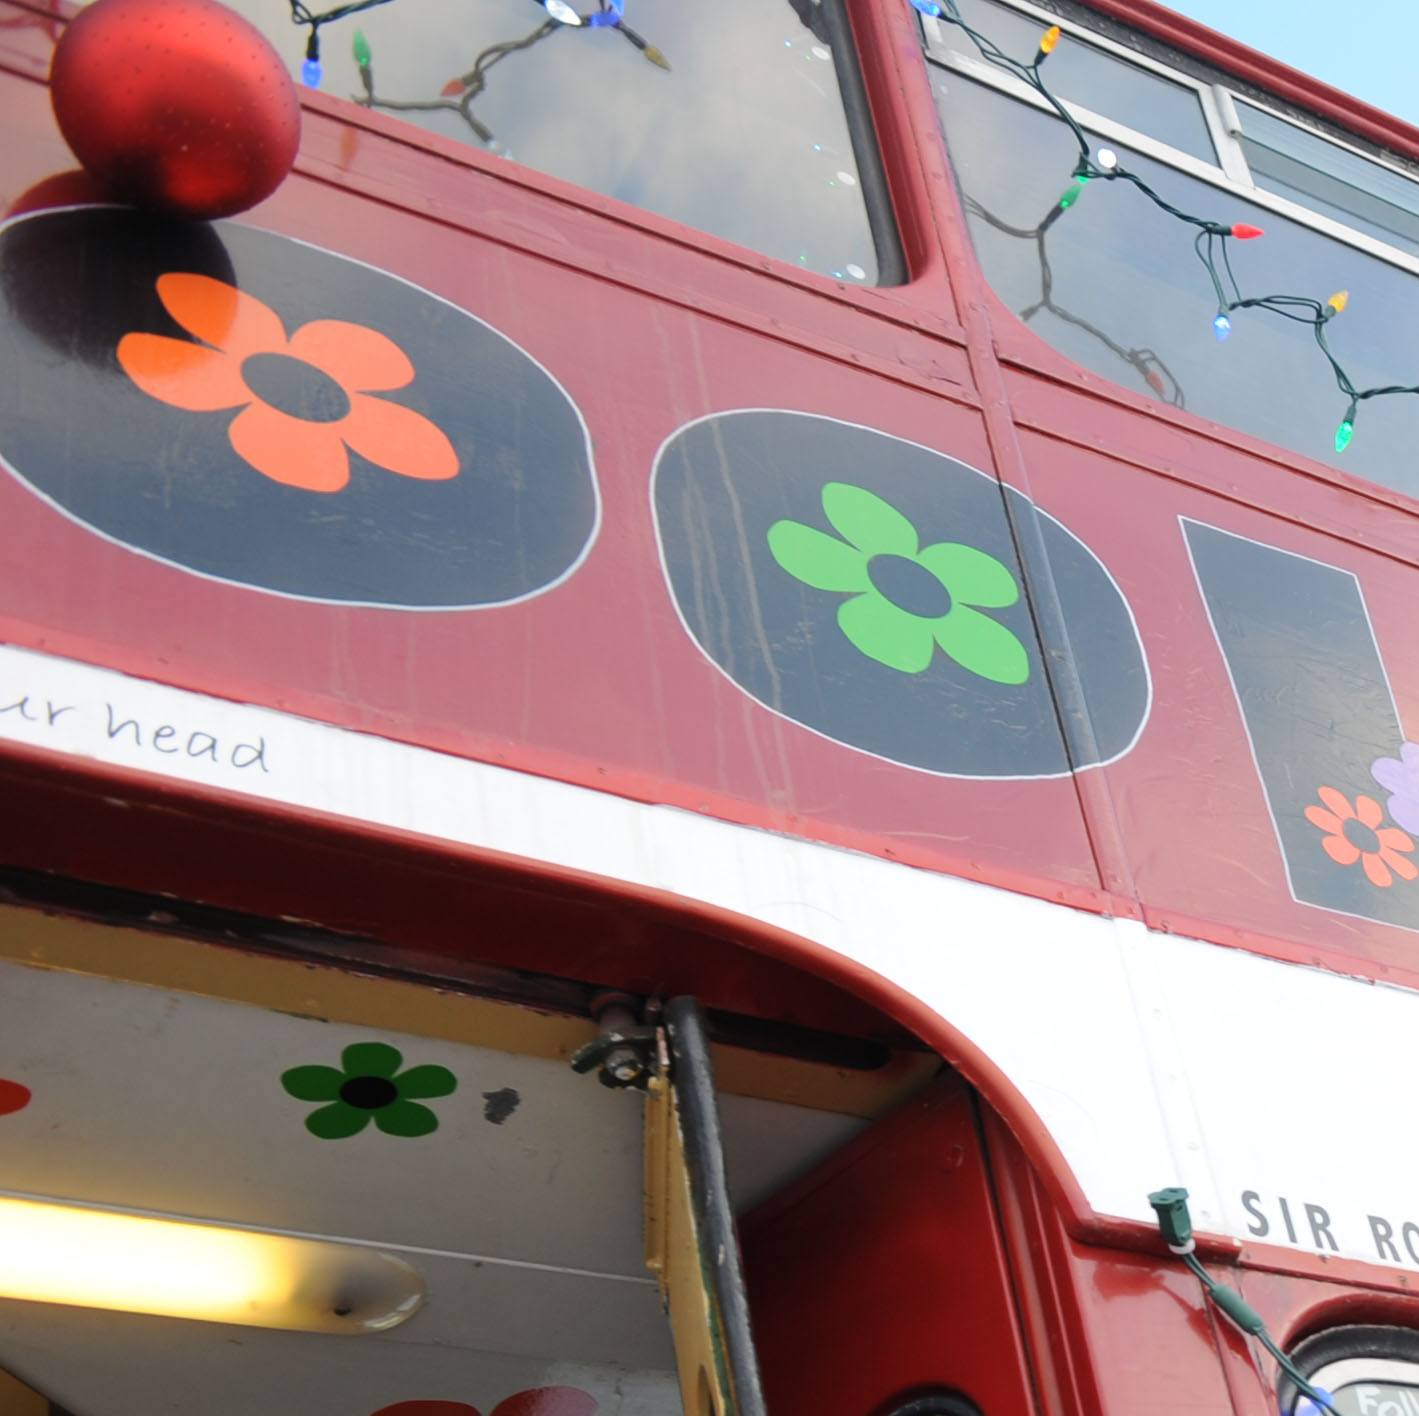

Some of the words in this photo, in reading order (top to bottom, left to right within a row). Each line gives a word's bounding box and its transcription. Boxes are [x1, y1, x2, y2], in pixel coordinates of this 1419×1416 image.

[0, 696, 75, 726] ur
[105, 702, 271, 773] head
[1241, 1190, 1340, 1252] SIR
